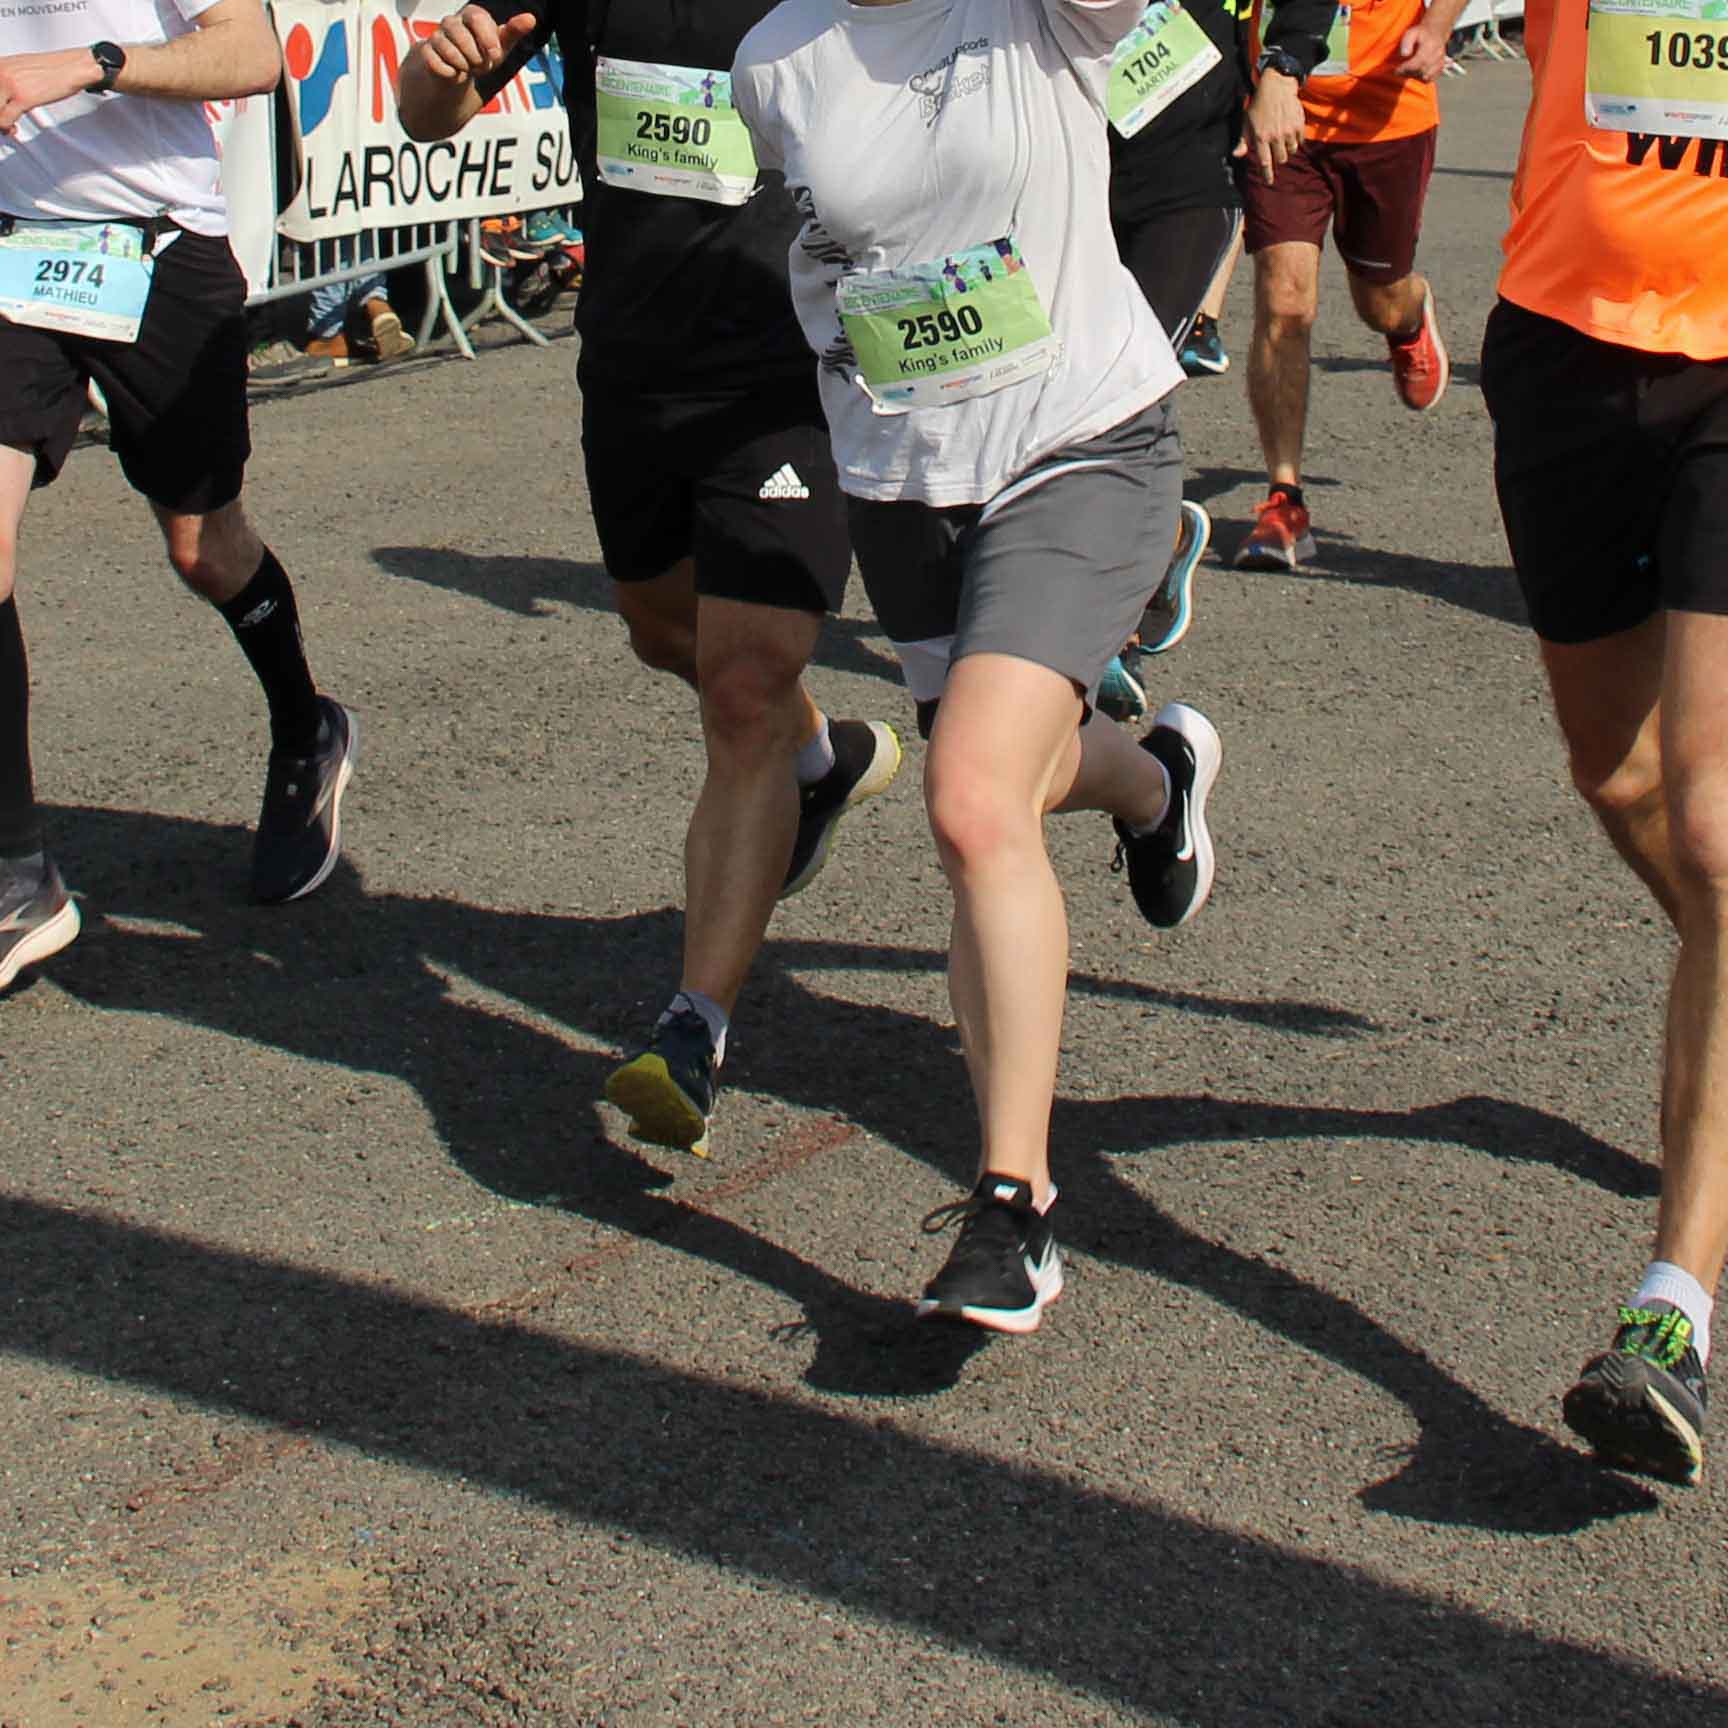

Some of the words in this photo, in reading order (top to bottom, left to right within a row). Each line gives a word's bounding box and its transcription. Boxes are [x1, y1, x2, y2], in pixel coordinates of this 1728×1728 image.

[1121, 40, 1171, 86] 1704
[1135, 61, 1179, 98] MARTIAL
[635, 110, 712, 147] 2590
[531, 129, 581, 192] SU
[626, 143, 671, 163] King's
[674, 148, 719, 171] family
[34, 259, 105, 290] 2974
[32, 285, 99, 306] MATHIEU
[896, 304, 984, 352] 2590
[897, 352, 950, 374] King's
[951, 335, 1005, 364] family
[758, 485, 810, 500] adidas
